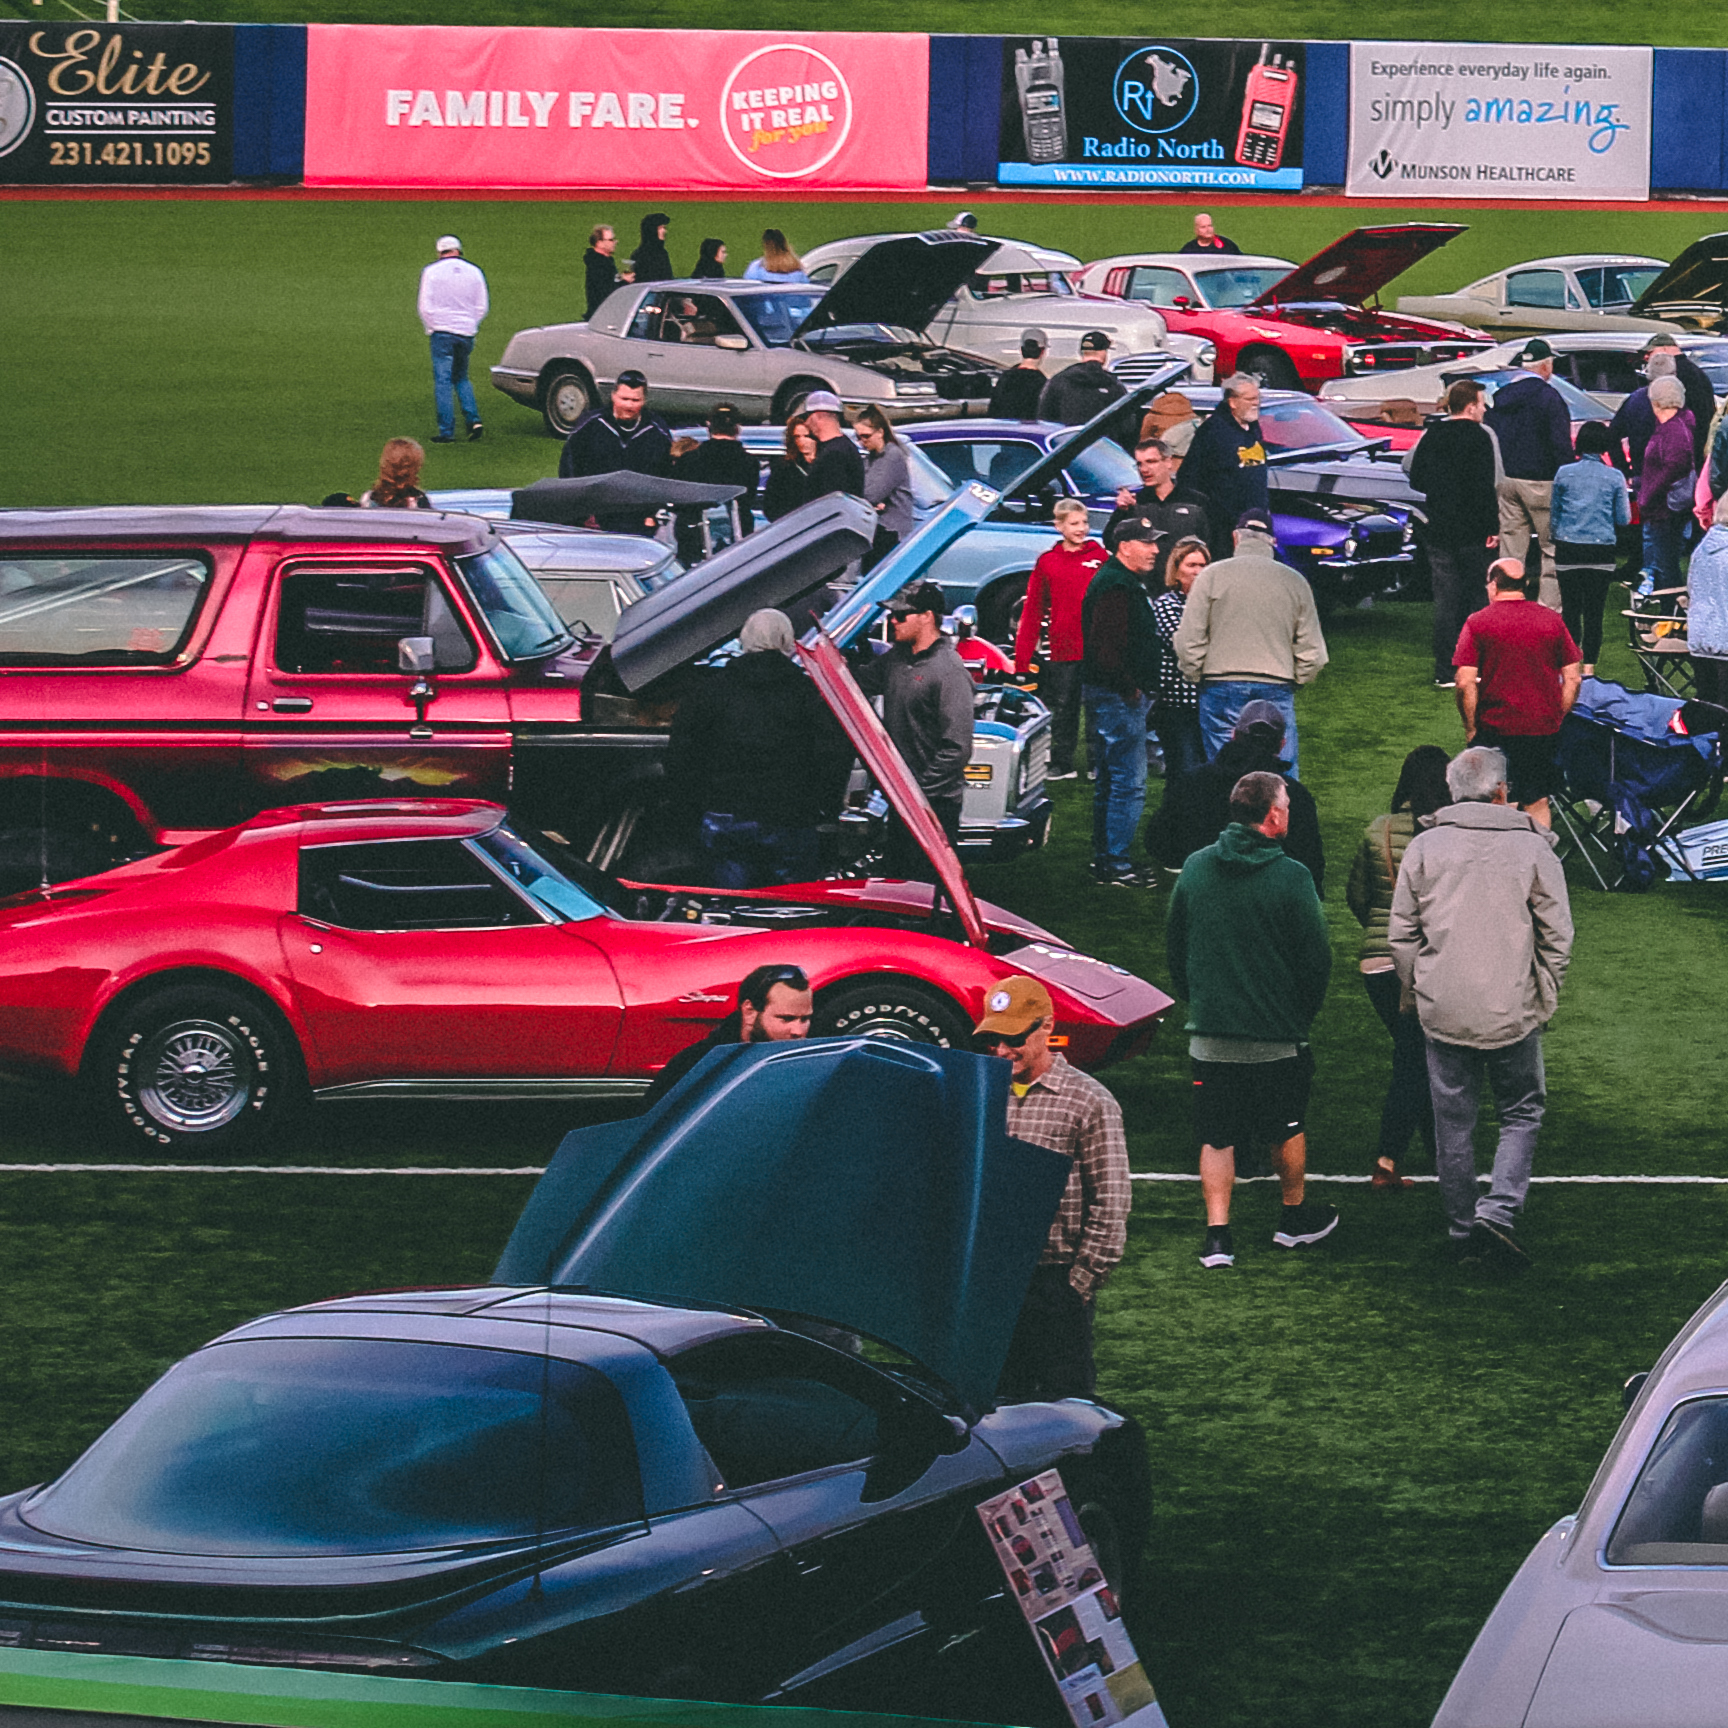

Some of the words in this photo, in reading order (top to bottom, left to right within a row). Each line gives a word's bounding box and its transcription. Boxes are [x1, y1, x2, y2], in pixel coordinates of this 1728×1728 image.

[29, 29, 212, 96] Elite
[1370, 60, 1454, 80] Experience
[1458, 61, 1530, 82] everyday
[1533, 62, 1559, 79] life
[1563, 65, 1612, 83] again.
[386, 88, 560, 127] FAMILY
[731, 80, 839, 111] KEEPING
[45, 109, 125, 126] CUSTOM
[127, 110, 216, 127] PAINTING
[740, 112, 765, 132] IT
[770, 103, 835, 129] REAL
[1369, 91, 1456, 131] simply
[747, 128, 785, 153] for
[786, 120, 829, 144] you
[1083, 136, 1151, 159] Radio
[1157, 138, 1225, 160] North
[49, 141, 212, 166] 231.421.1095
[1052, 168, 1256, 185] WWW.RADIONORTH.COM
[1399, 163, 1472, 181] MUNSON
[1476, 164, 1576, 183] HEALTHCARE
